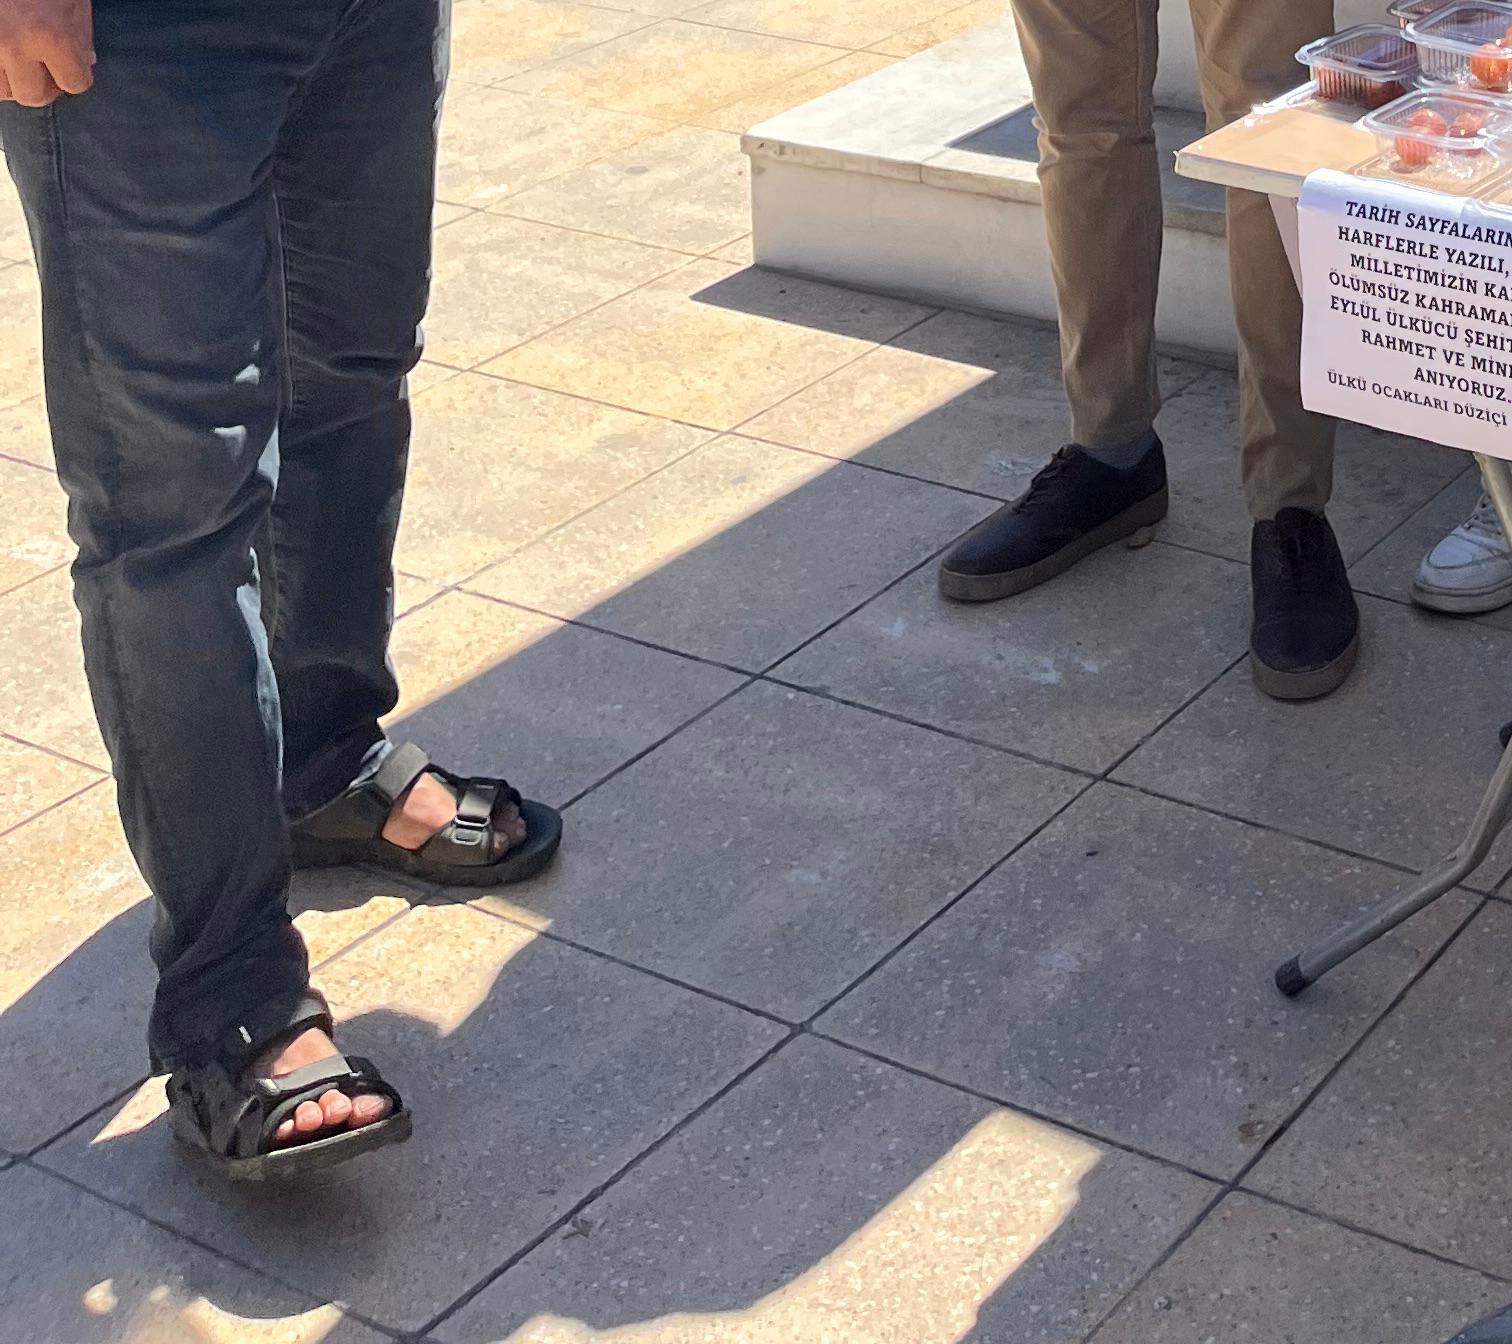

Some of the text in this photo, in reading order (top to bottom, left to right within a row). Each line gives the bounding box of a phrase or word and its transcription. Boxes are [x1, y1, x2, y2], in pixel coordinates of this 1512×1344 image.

[1346, 200, 1402, 225] TARİH
[1337, 225, 1439, 260] HARFLERLE
[1444, 247, 1510, 279] YAZILI,
[1329, 267, 1410, 305] ÖLÜMSÜZ
[1350, 252, 1478, 295] MİLLETİMİZİN
[1330, 295, 1381, 323] EYLÜL
[1386, 307, 1459, 340] ÜLKÜCÜ
[1361, 329, 1437, 360] RAHMET
[1442, 348, 1466, 367] VE
[1327, 368, 1367, 391] ÜLKÜ
[1372, 383, 1450, 412] OCAKLARI
[1453, 402, 1508, 428] DÜZİÇİ
[1413, 367, 1512, 404] ANIYORUZ.
